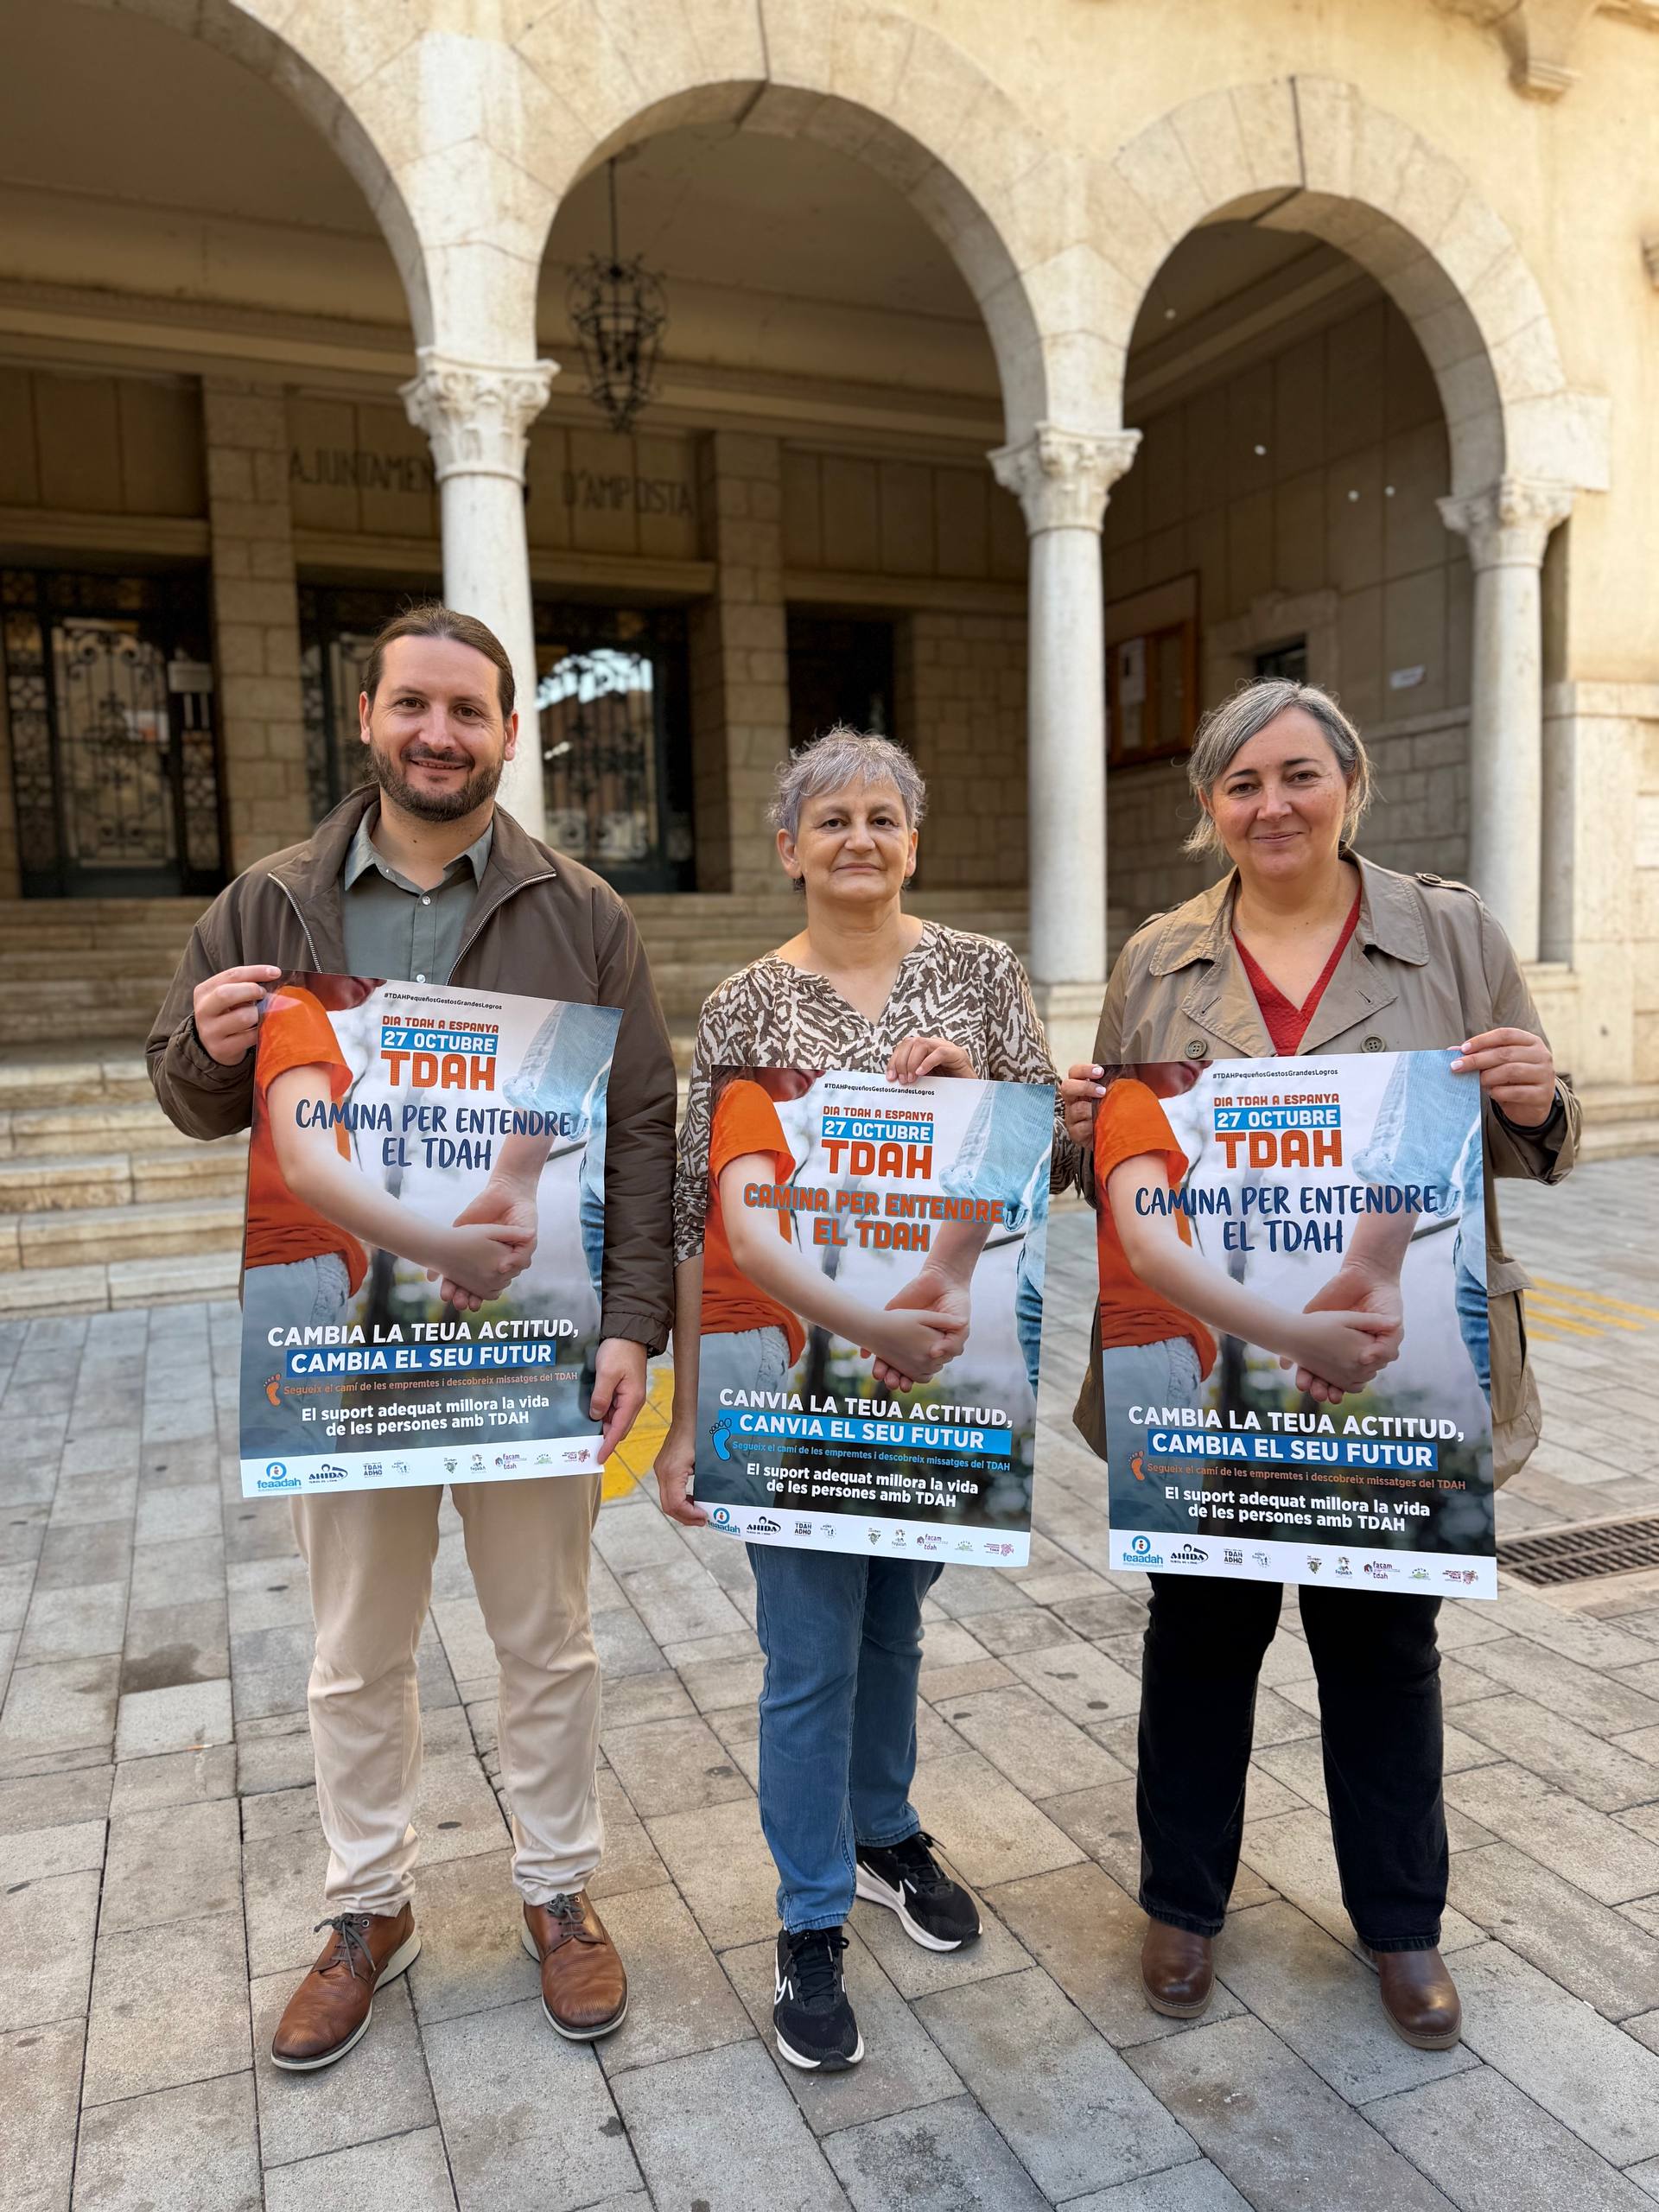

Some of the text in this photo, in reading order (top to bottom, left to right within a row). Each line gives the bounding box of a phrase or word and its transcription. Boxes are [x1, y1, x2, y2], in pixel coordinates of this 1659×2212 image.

[289, 444, 694, 518] AJUNTAMEN D'AMPOSTA
[384, 993, 503, 1009] #TDAHPequeñosGestosGrandesLogros
[383, 1015, 499, 1033] DIA TDAH A ESPANYA
[385, 1031, 494, 1052] 27 OCTUBRE
[381, 1051, 497, 1091] TDAH
[1212, 1068, 1338, 1079] #TDAHPequeñosGestosGrandesLogros
[824, 1083, 935, 1096] #TDAHPequeñosGestosGrandesLogros
[1214, 1093, 1339, 1107] DIA TDAH A ESPANYA
[296, 1099, 571, 1137] CAMINA PER ENTENDRE
[823, 1106, 933, 1122] DIA TDAH A ESPANYA
[1217, 1109, 1338, 1128] 27 OCTUBRE
[824, 1121, 930, 1141] 27 OCTUBRE
[382, 1137, 491, 1171] EL TDAH
[821, 1139, 932, 1179] TDAH
[1215, 1129, 1343, 1169] TDAH
[743, 1182, 1007, 1224] CAMINA PER ENTENDRE
[1135, 1184, 1440, 1216] CAMINA PER ENTENDRE
[813, 1217, 931, 1252] EL TDAH
[1224, 1219, 1343, 1254] EL TDAH
[268, 1319, 579, 1347] CAMBIA LA TEUA ACTITUD,
[291, 1344, 551, 1374] CAMBIA EL SEU FUTUR
[283, 1386, 321, 1395] Segueix
[335, 1382, 358, 1392] camí
[360, 1382, 372, 1391] de
[374, 1382, 386, 1390] les
[390, 1379, 440, 1390] empremtes
[447, 1376, 494, 1387] descobreix
[496, 1375, 538, 1384] missatges
[539, 1373, 553, 1382] del
[555, 1372, 577, 1381] TDAH
[302, 1395, 550, 1422] El suport adequat millora la vida
[719, 1389, 1014, 1428] CANVIA LA TEUA ACTITUD,
[326, 1411, 530, 1436] de les persones amb TDAH
[740, 1414, 984, 1449] CANVIA EL SEU FUTUR
[1128, 1406, 1465, 1443] CAMBIA LA TEUA ACTITUD,
[732, 1441, 766, 1452] Segueix
[767, 1443, 775, 1452] el
[778, 1445, 797, 1453] camí
[798, 1446, 809, 1454] de
[811, 1446, 823, 1455] les
[824, 1449, 872, 1459] empremtes
[879, 1452, 925, 1464] descobreix
[926, 1457, 969, 1468] missatges
[970, 1459, 984, 1469] del
[986, 1461, 1010, 1471] TDAH
[1152, 1433, 1433, 1467] CAMBIA EL SEU FUTUR
[257, 1478, 302, 1489] feaadah
[747, 1462, 978, 1494] El suport adequat millora la vida
[1147, 1463, 1182, 1474] Segueix
[1185, 1465, 1194, 1473] el
[1196, 1466, 1218, 1475] camí
[1220, 1467, 1231, 1476] de
[1234, 1468, 1247, 1477] les
[1249, 1471, 1303, 1480] empremtes
[1311, 1473, 1364, 1484] descobreix
[1367, 1476, 1416, 1488] missatges
[1419, 1479, 1434, 1488] del
[1438, 1479, 1465, 1490] TDAH
[766, 1479, 957, 1508] de les persones amb TDAH
[1165, 1486, 1430, 1516] El suport adequat millora la vida
[747, 1523, 777, 1532] AHIDA
[1188, 1504, 1406, 1532] de les persones amb TDAH
[1123, 1553, 1163, 1564] feaadah
